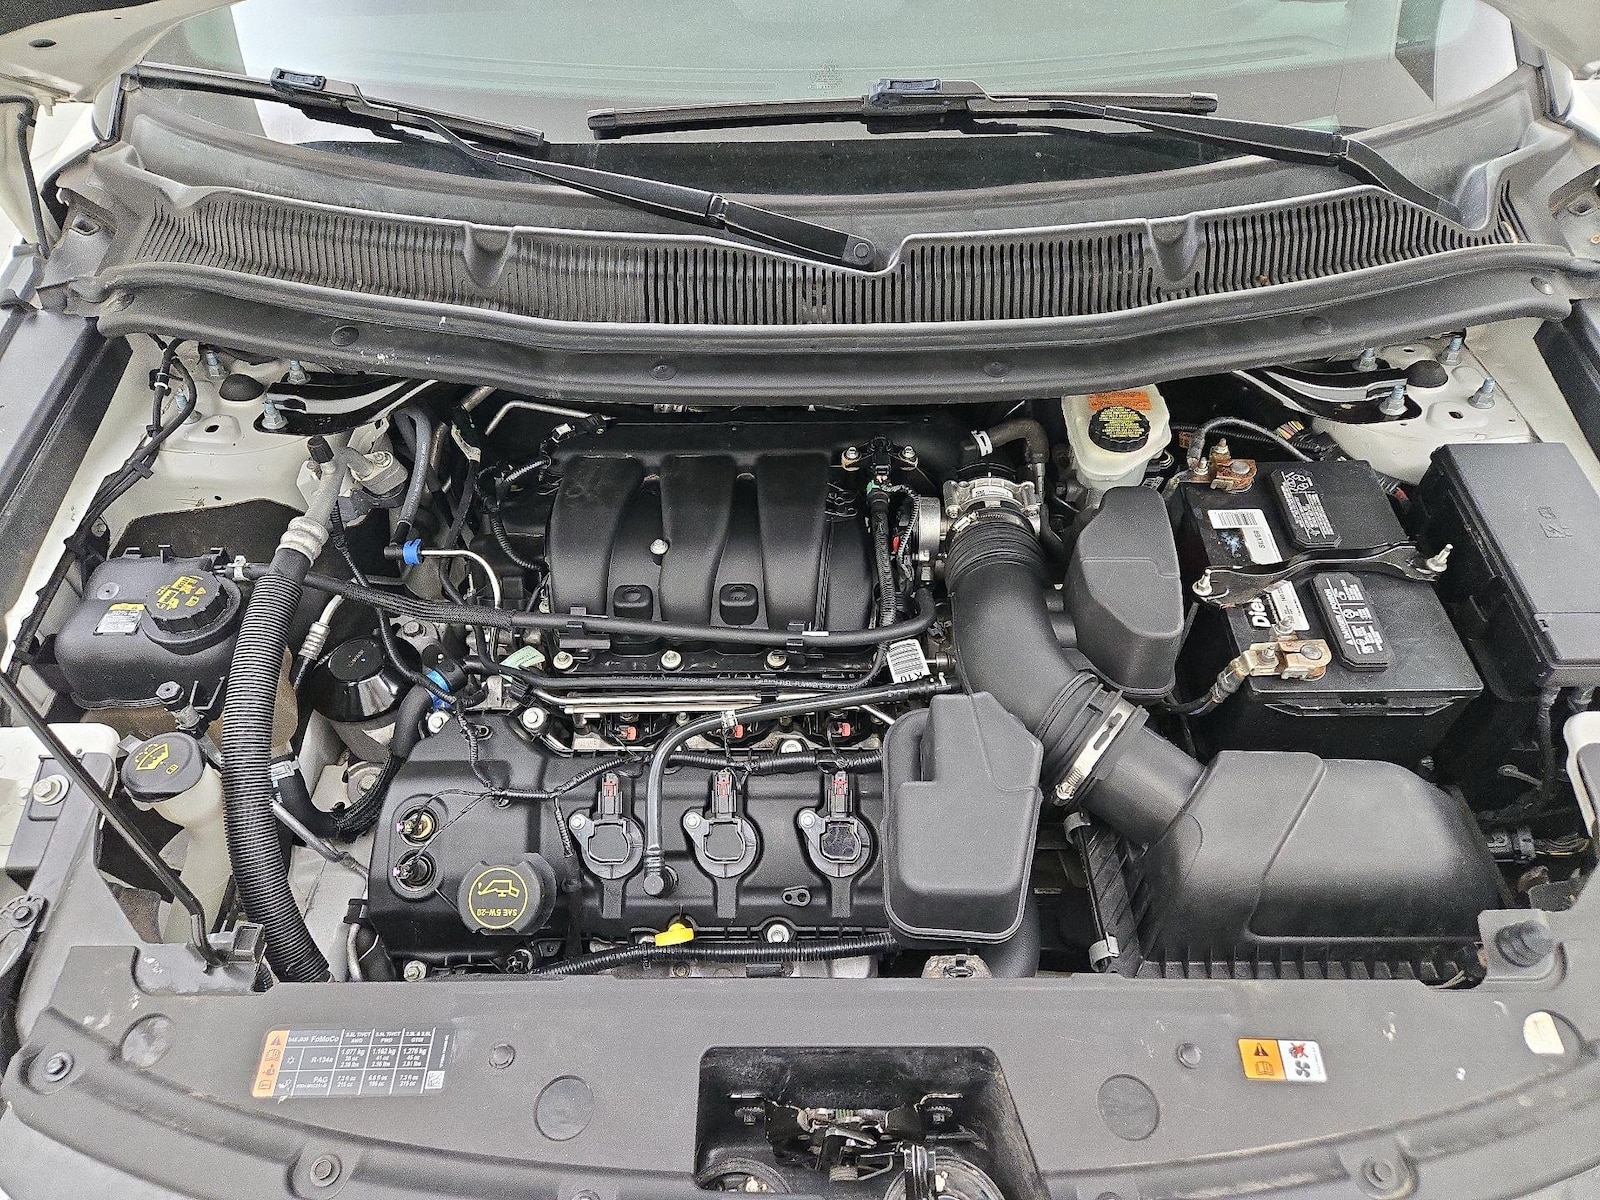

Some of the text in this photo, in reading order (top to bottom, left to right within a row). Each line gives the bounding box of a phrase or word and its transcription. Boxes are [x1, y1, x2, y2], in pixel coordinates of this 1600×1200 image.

[476, 908, 518, 916] SAE 5W-20
[310, 1034, 340, 1042] FoMoCo
[357, 1048, 366, 1056] kg
[388, 1048, 397, 1056] kg
[418, 1048, 428, 1056] kg
